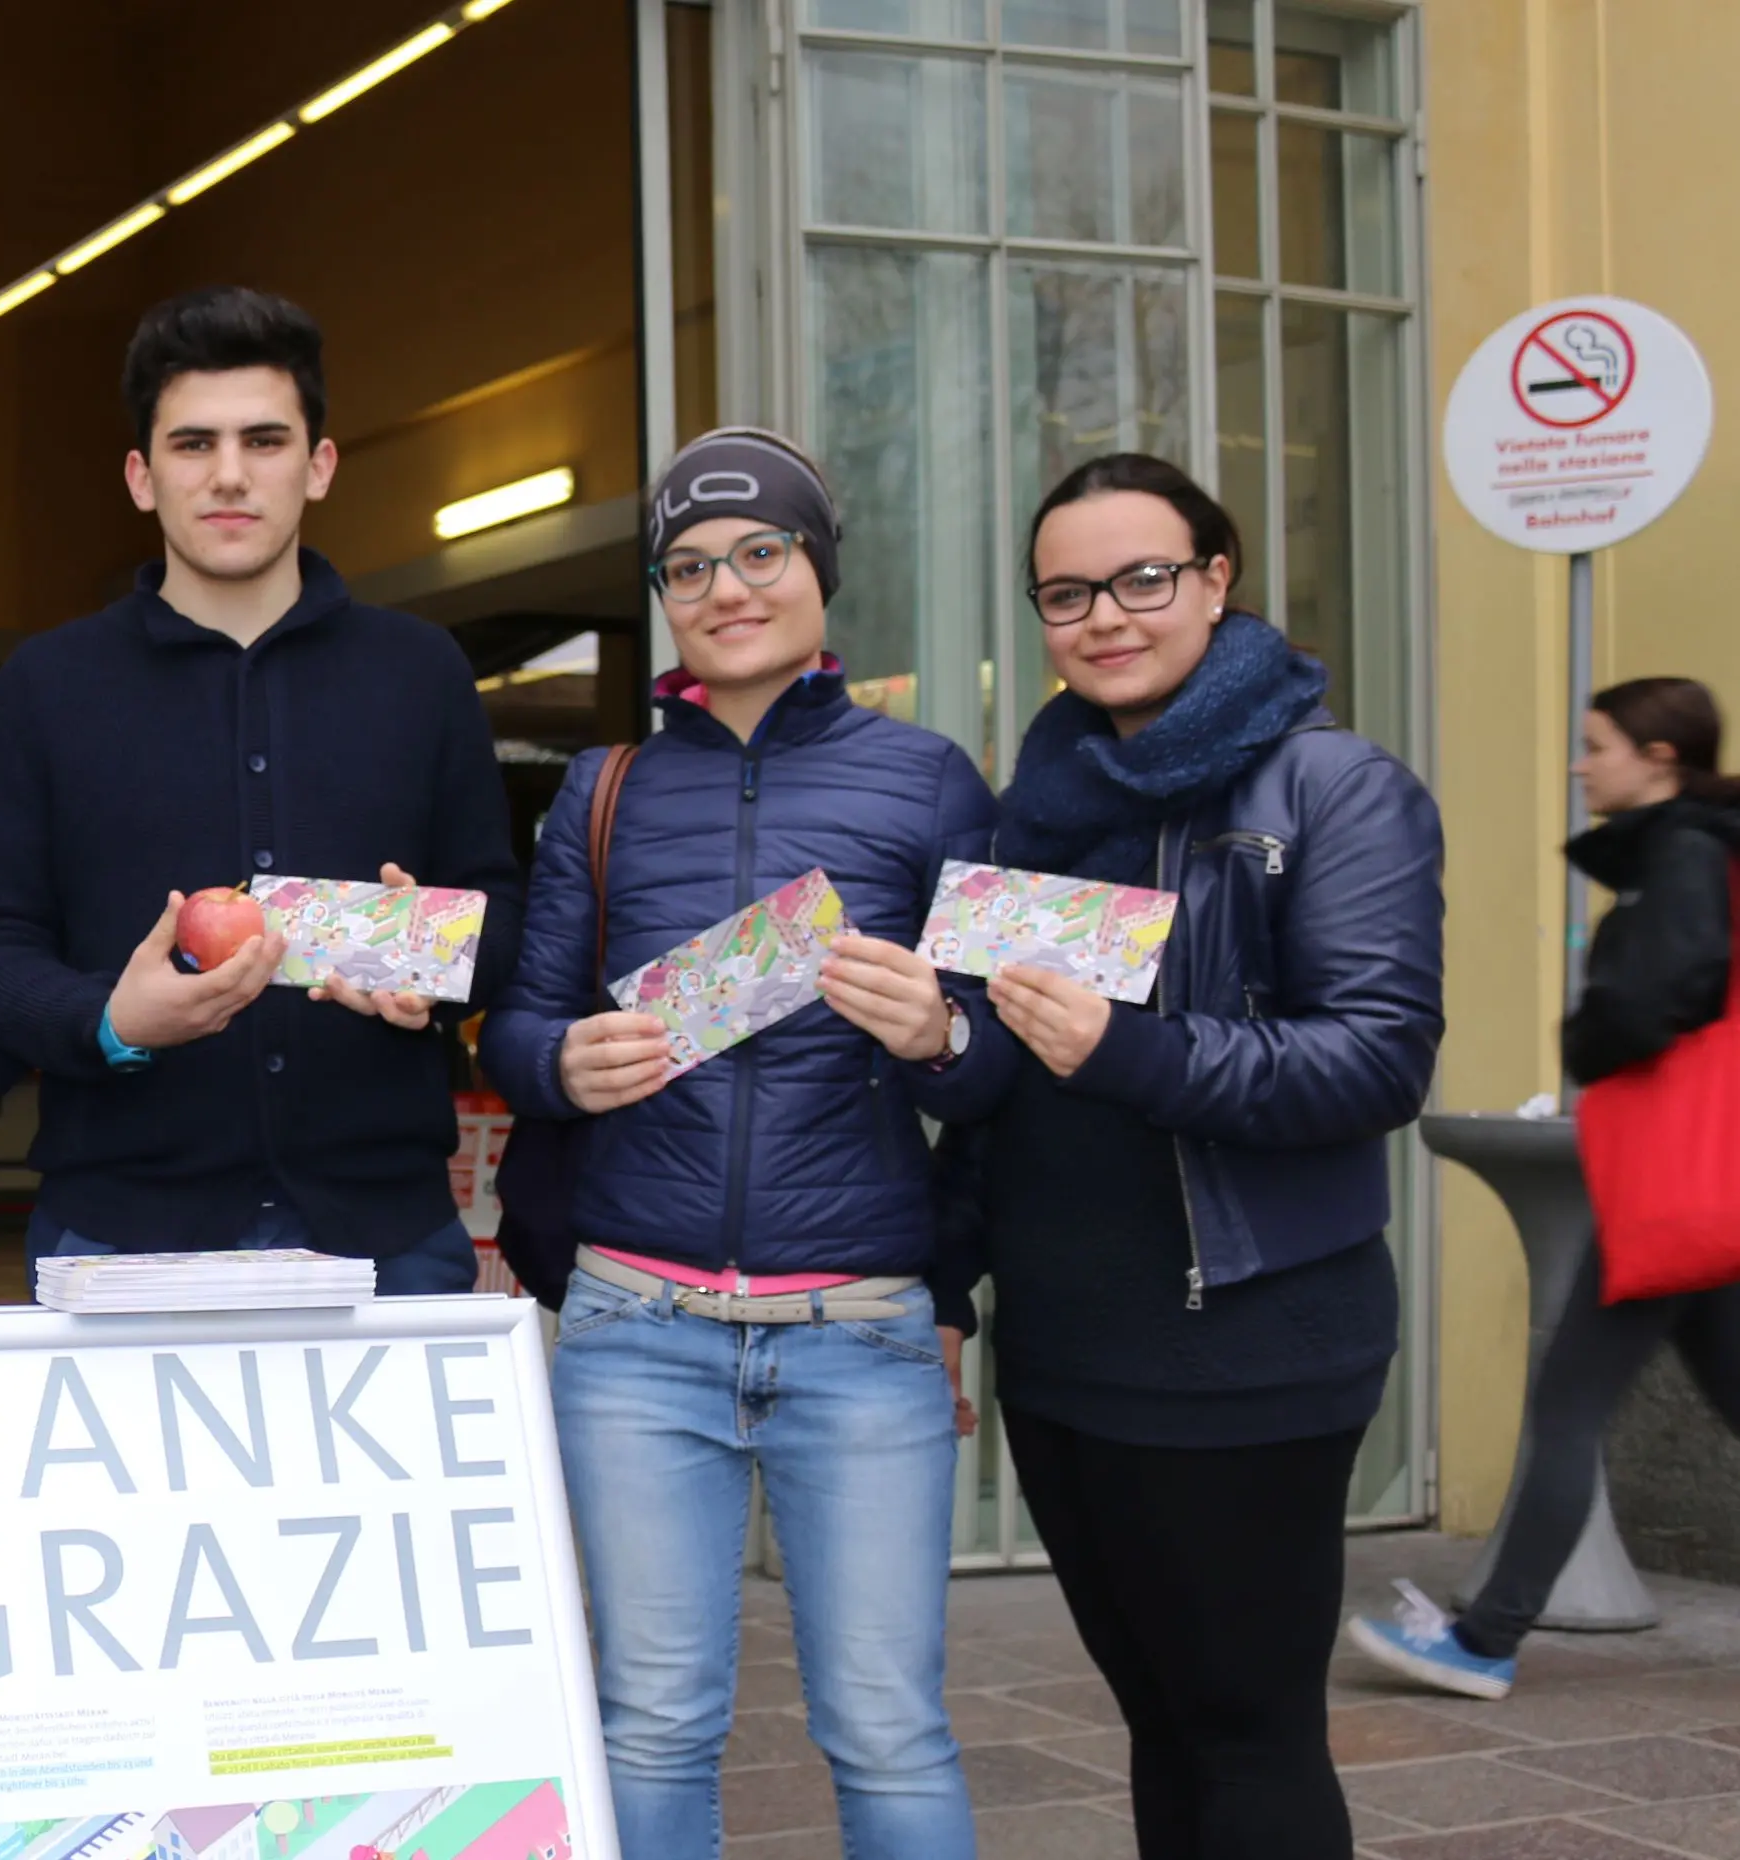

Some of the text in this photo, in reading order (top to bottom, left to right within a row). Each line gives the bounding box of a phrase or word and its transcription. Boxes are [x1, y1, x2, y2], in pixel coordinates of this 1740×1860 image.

[1495, 429, 1651, 454] Vietato fumare
[1498, 450, 1647, 474] nella stazione
[1525, 506, 1618, 529] Bahnhof
